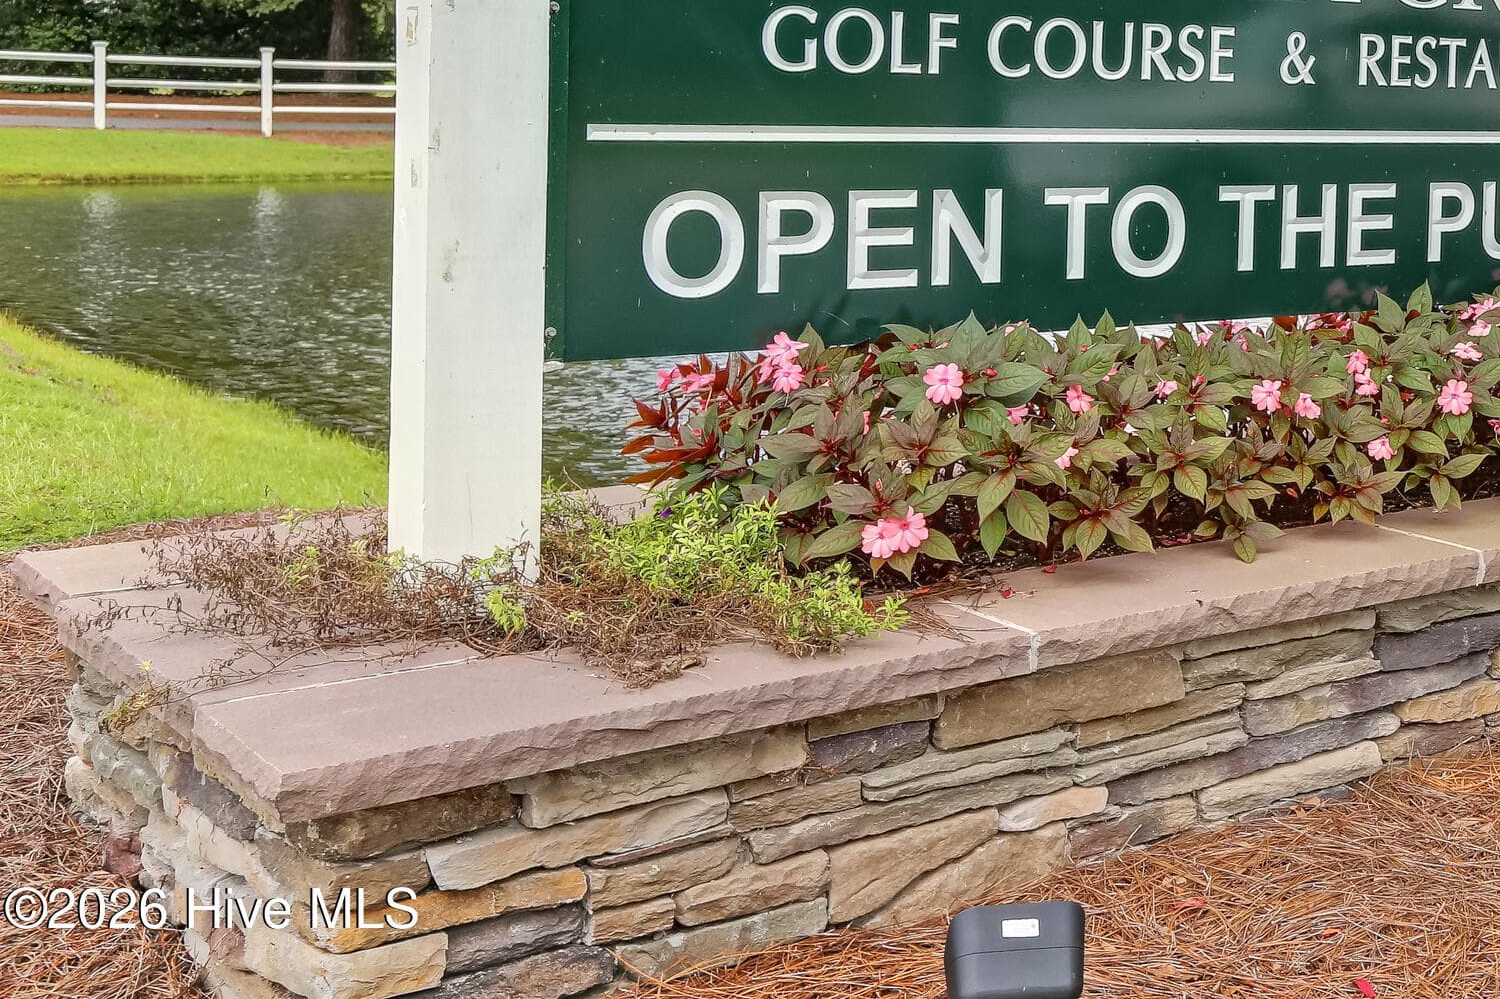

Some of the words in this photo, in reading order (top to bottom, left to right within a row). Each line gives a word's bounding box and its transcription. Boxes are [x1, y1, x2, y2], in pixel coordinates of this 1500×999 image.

[760, 5, 961, 75] GOLF
[986, 15, 1237, 83] COURSE
[1278, 31, 1317, 86] &
[641, 188, 1004, 300] OPEN
[1044, 184, 1187, 281] TO
[1218, 182, 1398, 272] THE
